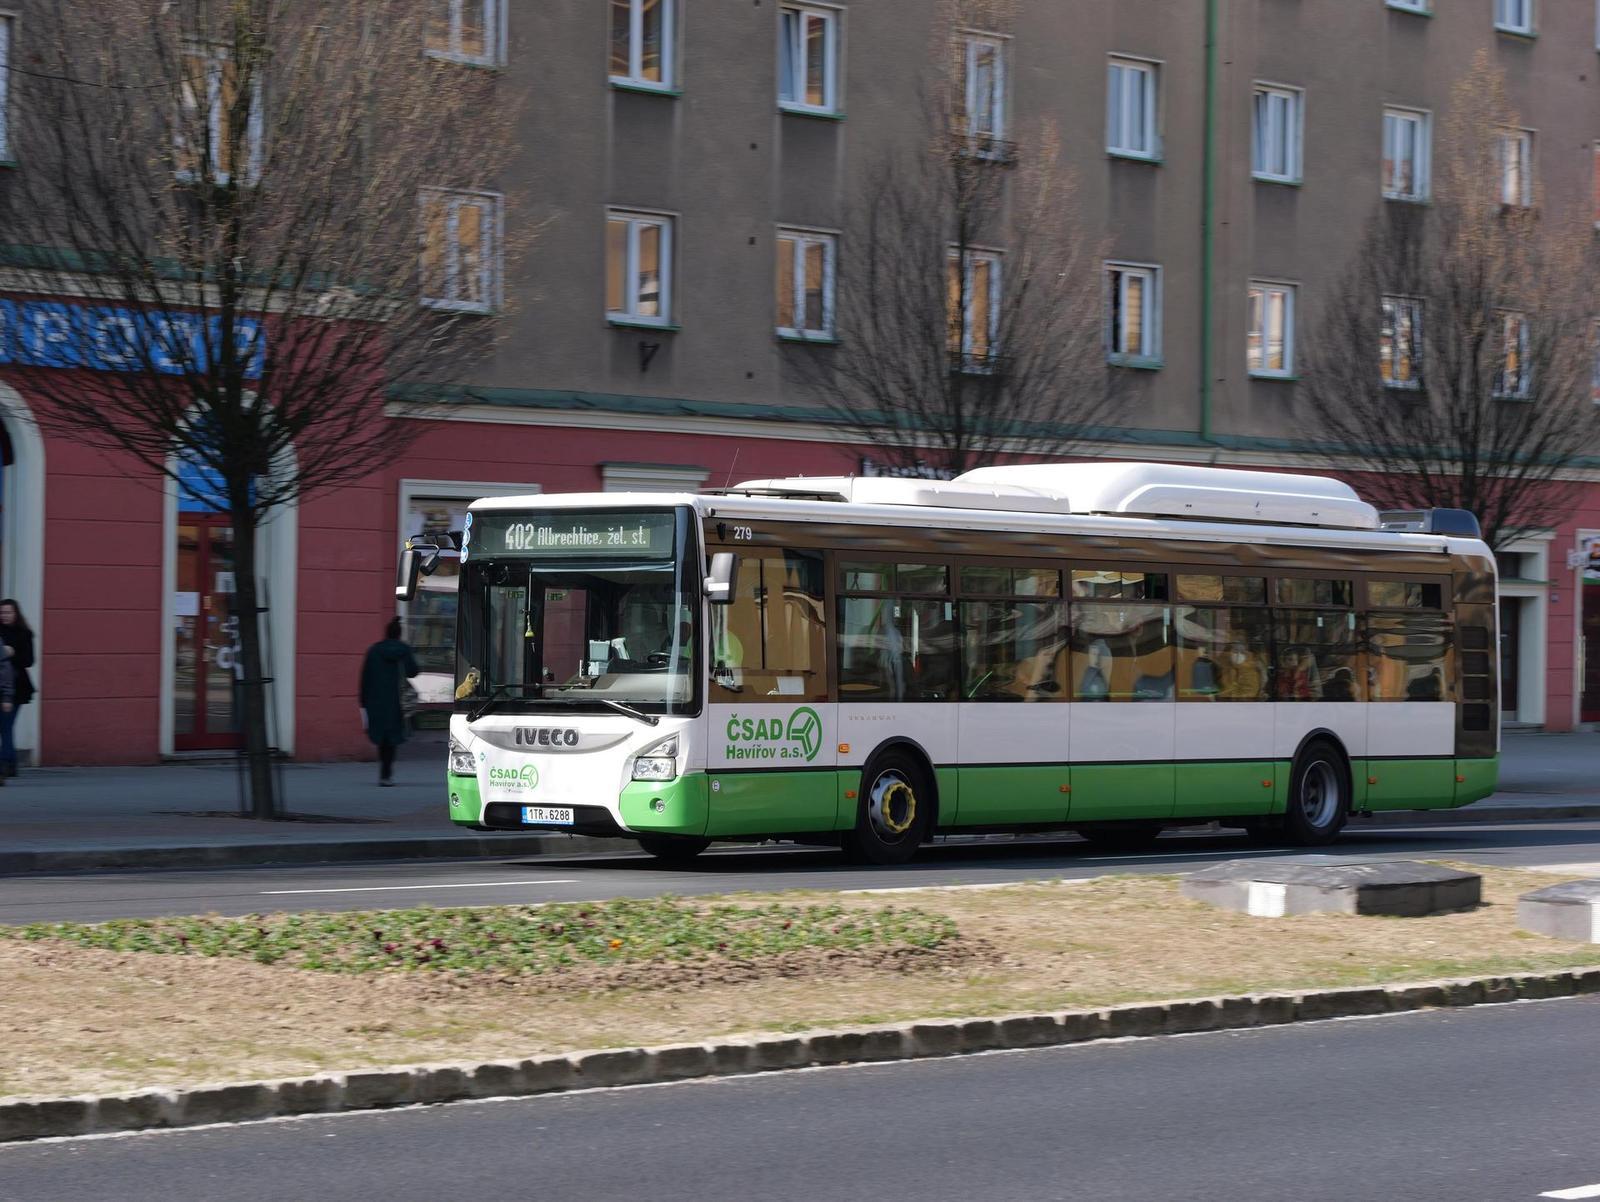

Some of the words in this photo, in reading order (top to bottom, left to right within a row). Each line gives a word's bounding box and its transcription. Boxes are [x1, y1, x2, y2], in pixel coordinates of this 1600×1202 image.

[505, 523, 534, 550] 402
[537, 526, 602, 546] Albrechtice,
[607, 525, 627, 545] žel.
[631, 525, 646, 545] st.
[733, 526, 752, 540] 279
[726, 713, 783, 741] ČSAD
[515, 727, 579, 746] IVECO
[725, 743, 776, 760] Havířov
[780, 746, 803, 758] a.s.
[489, 766, 518, 779] ČSAD
[529, 808, 544, 820] 1TR
[549, 809, 570, 821] 6288
